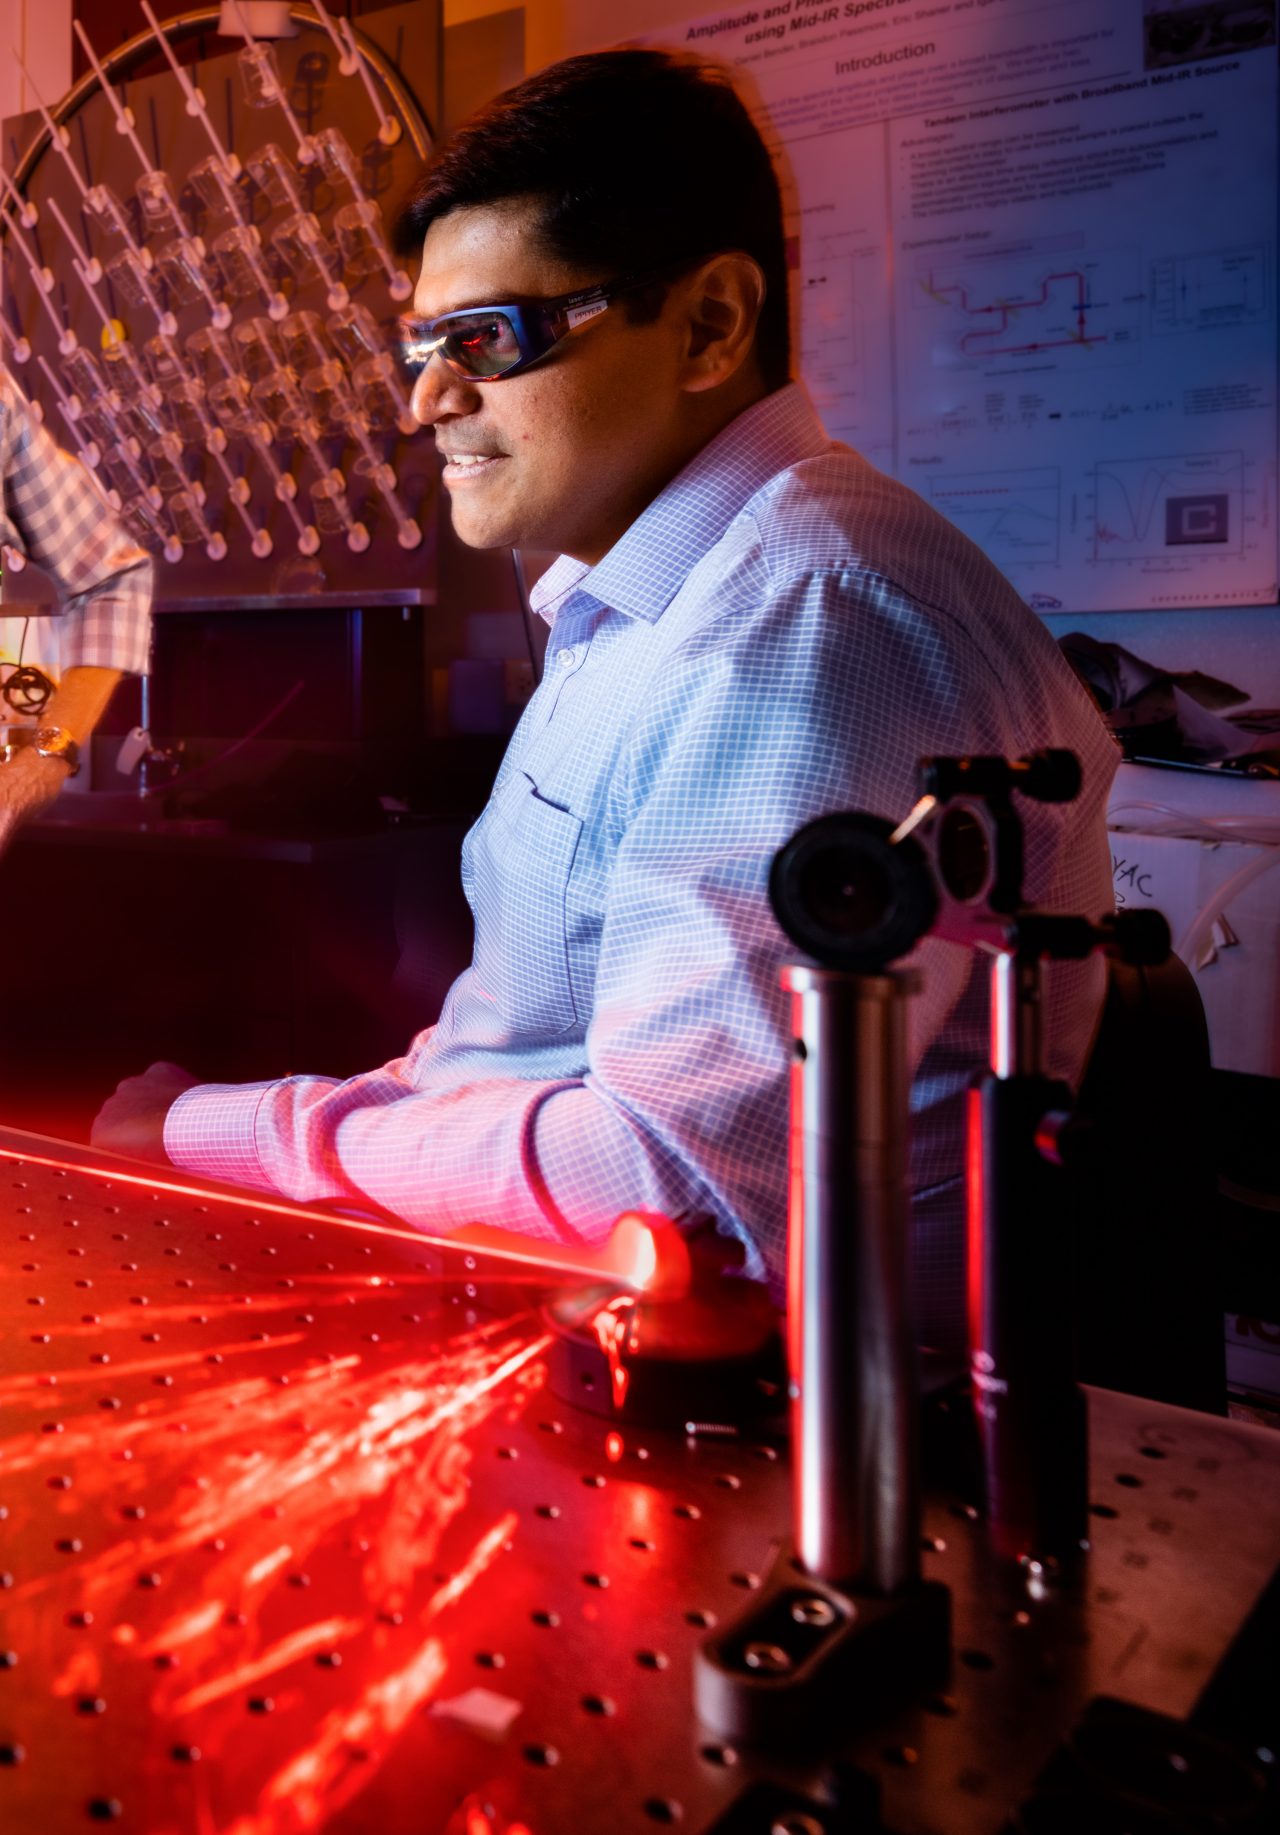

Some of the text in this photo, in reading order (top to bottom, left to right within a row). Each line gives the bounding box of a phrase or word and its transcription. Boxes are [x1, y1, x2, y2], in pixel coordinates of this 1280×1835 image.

[686, 9, 759, 41] Amplitude
[763, 0, 791, 20] and
[744, 24, 785, 44] using
[789, 8, 838, 32] Mid-IR
[836, 41, 936, 75] Introduction
[924, 61, 1240, 128] Tandem Interferometer with Broadband Mid-IR Source
